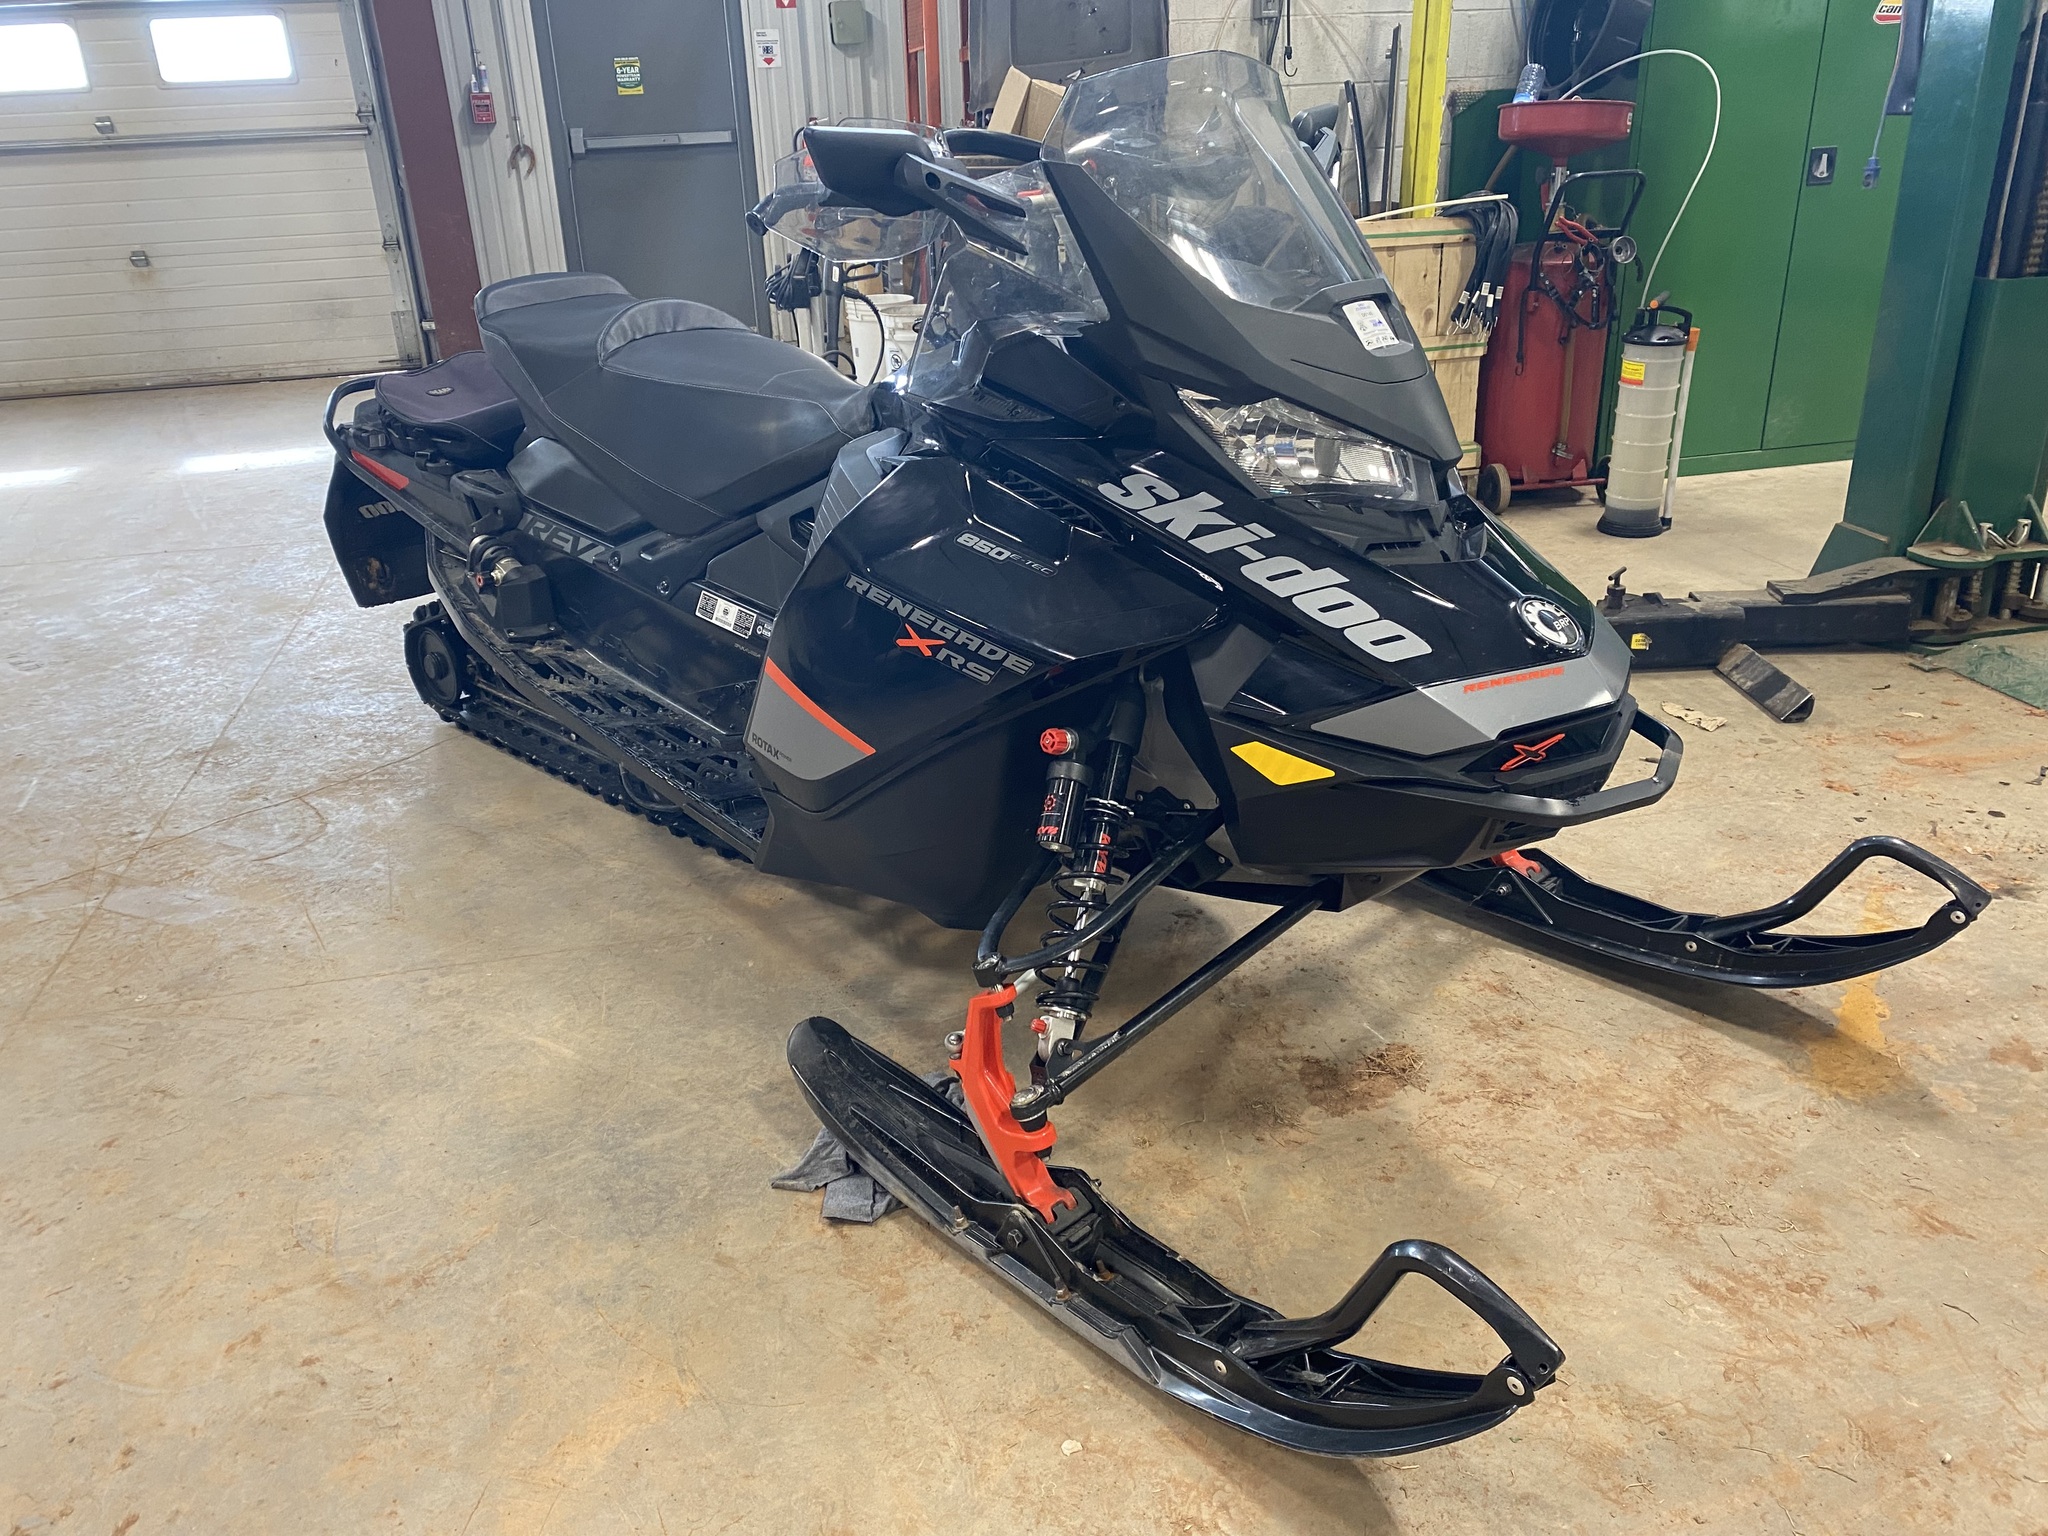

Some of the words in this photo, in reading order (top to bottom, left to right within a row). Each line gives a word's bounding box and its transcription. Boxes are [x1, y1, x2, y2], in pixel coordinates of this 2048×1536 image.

[957, 533, 1011, 561] 850
[1010, 553, 1054, 575] E-TEC
[846, 584, 1034, 675] RENEGADE
[1553, 617, 1571, 631] BRP
[895, 623, 946, 657] X
[936, 647, 995, 682] RS
[1463, 665, 1565, 694] RENEGADE
[752, 732, 779, 760] ROTAX
